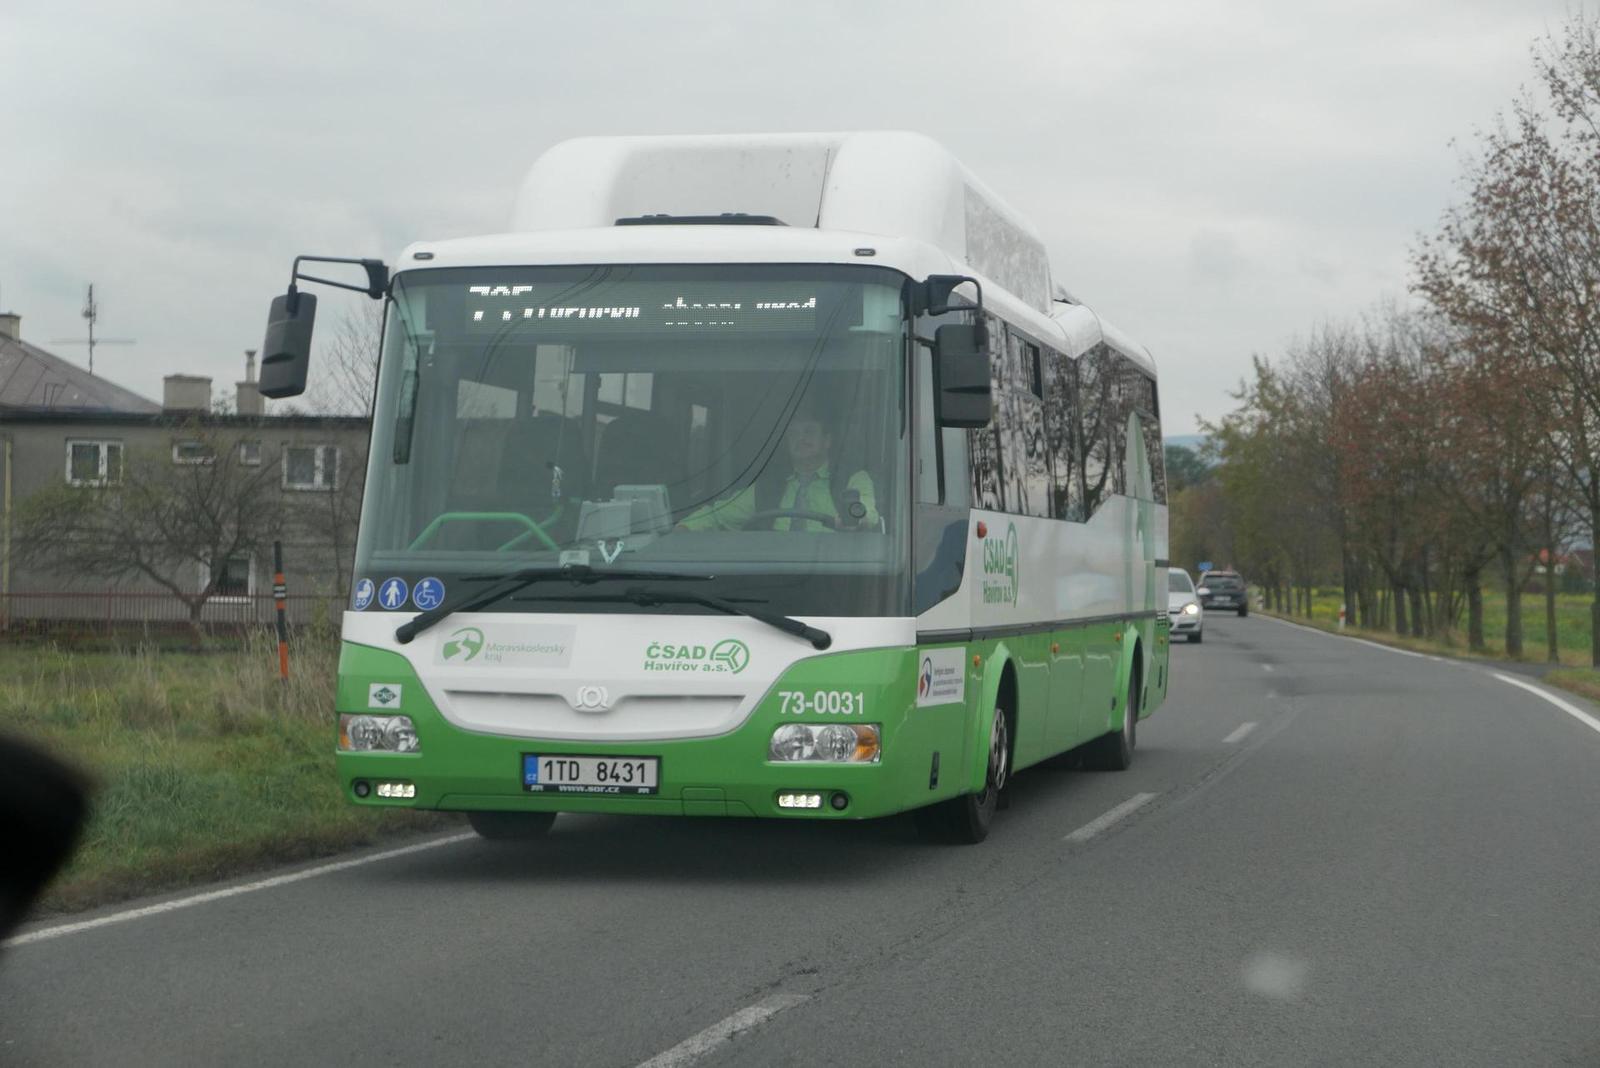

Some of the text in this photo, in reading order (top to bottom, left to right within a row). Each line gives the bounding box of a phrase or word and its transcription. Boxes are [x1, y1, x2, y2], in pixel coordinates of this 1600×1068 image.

[646, 641, 707, 660] ČSAD
[644, 661, 728, 672] Havířov a.s.
[778, 691, 864, 714] 73-0031
[544, 760, 646, 783] 1TD 8431
[558, 785, 620, 793] www.sor.cz
